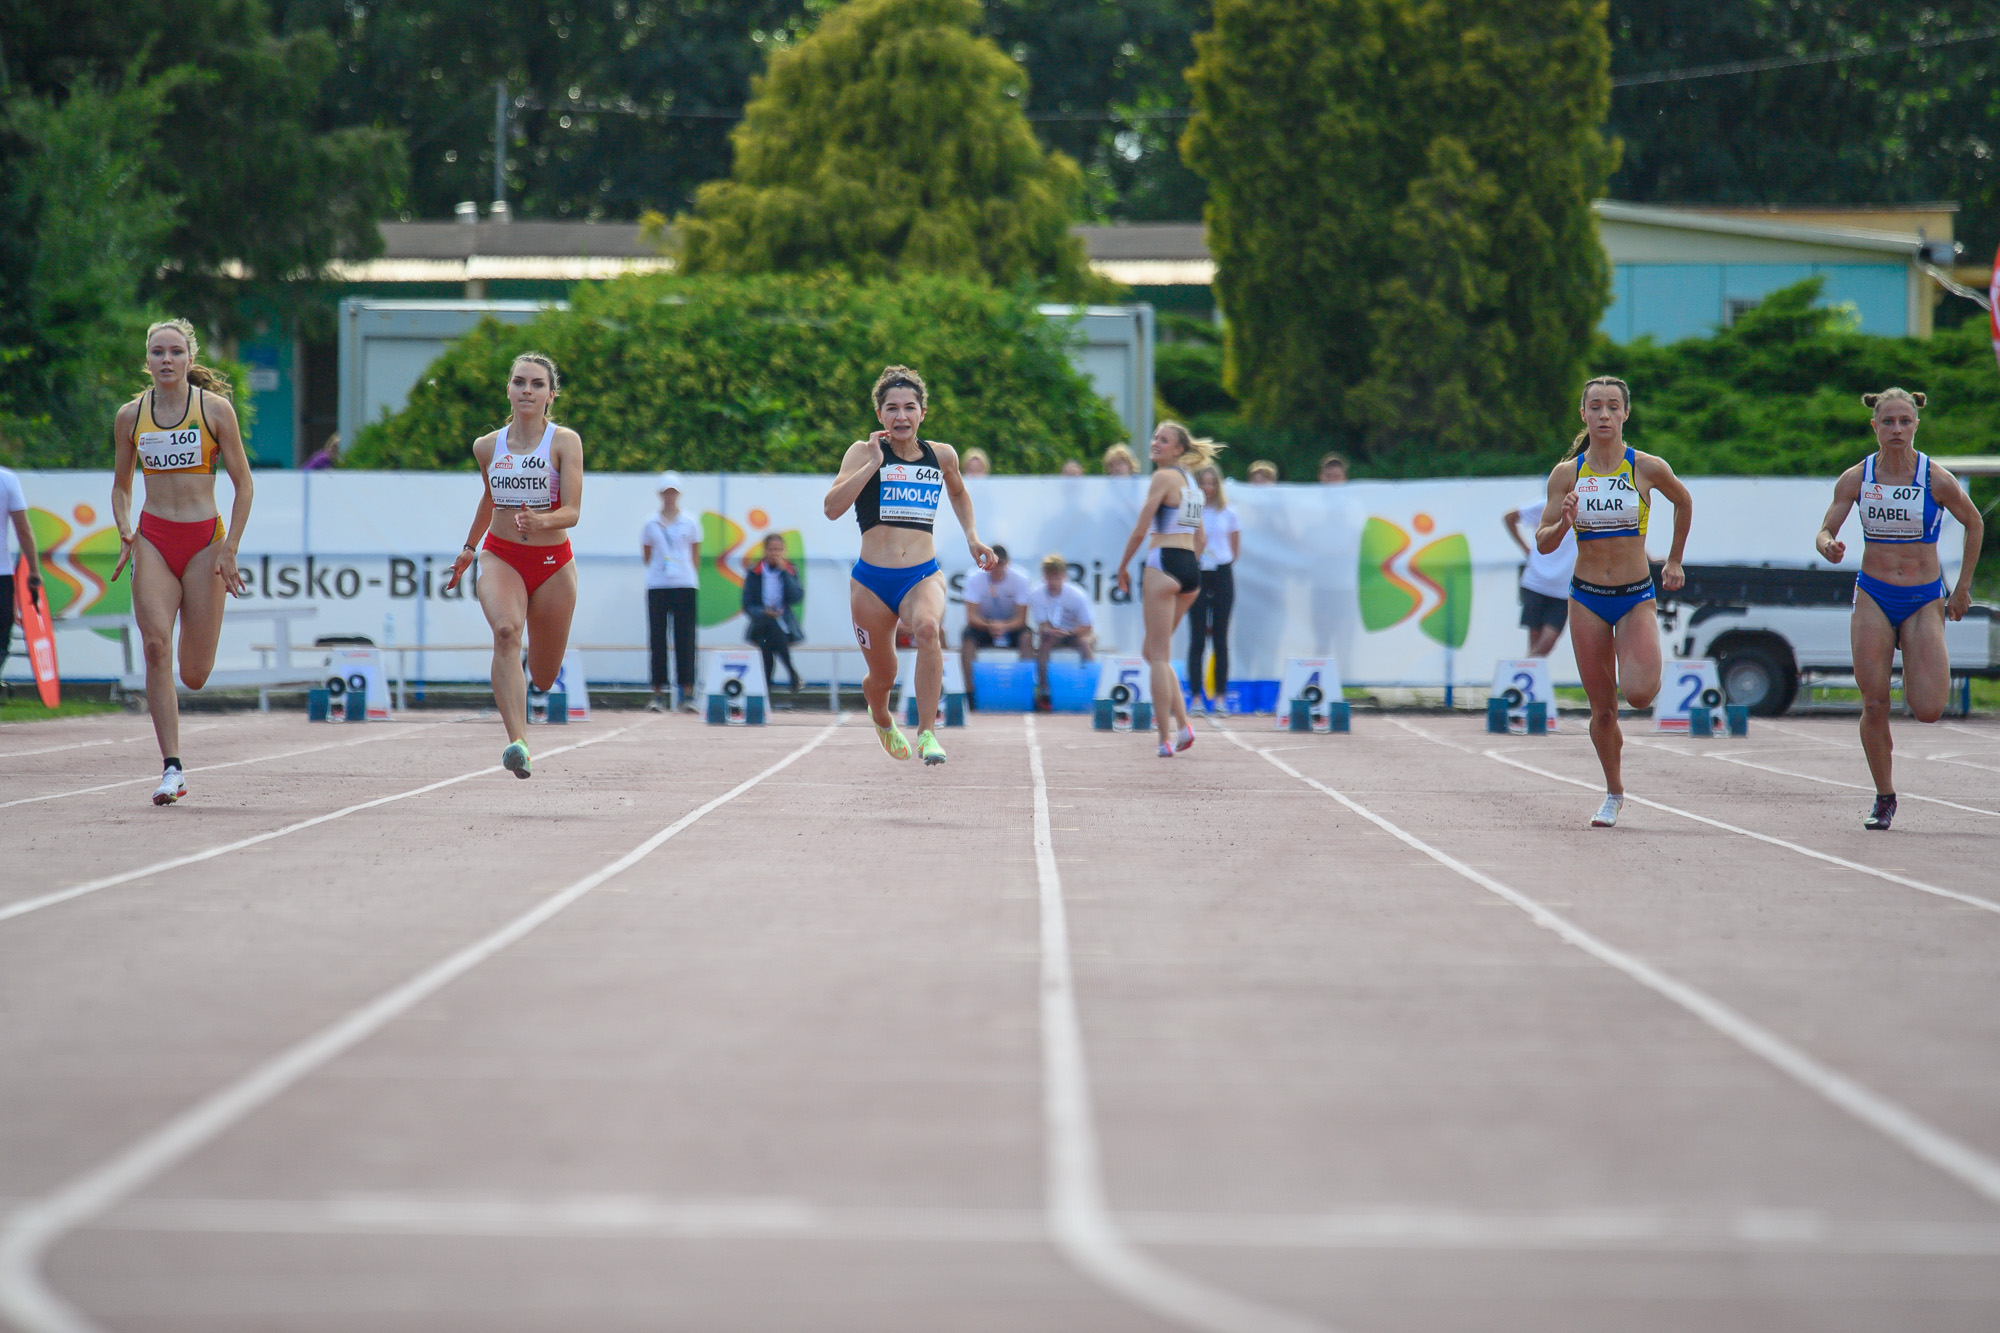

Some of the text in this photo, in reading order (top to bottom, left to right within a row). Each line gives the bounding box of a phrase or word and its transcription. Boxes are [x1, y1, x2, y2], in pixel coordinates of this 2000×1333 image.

[170, 431, 197, 445] 160
[145, 452, 196, 467] GAJOSZ
[521, 456, 546, 469] 660
[916, 468, 940, 482] 644
[490, 476, 547, 490] CHROSTEK
[882, 487, 939, 506] ZIMOLĄG
[1892, 487, 1921, 501] 607
[1586, 498, 1624, 511] KLAR
[1868, 506, 1911, 522] BĄBEL
[857, 627, 866, 645] 6
[1120, 670, 1140, 702] 5
[1678, 674, 1702, 712] 2
